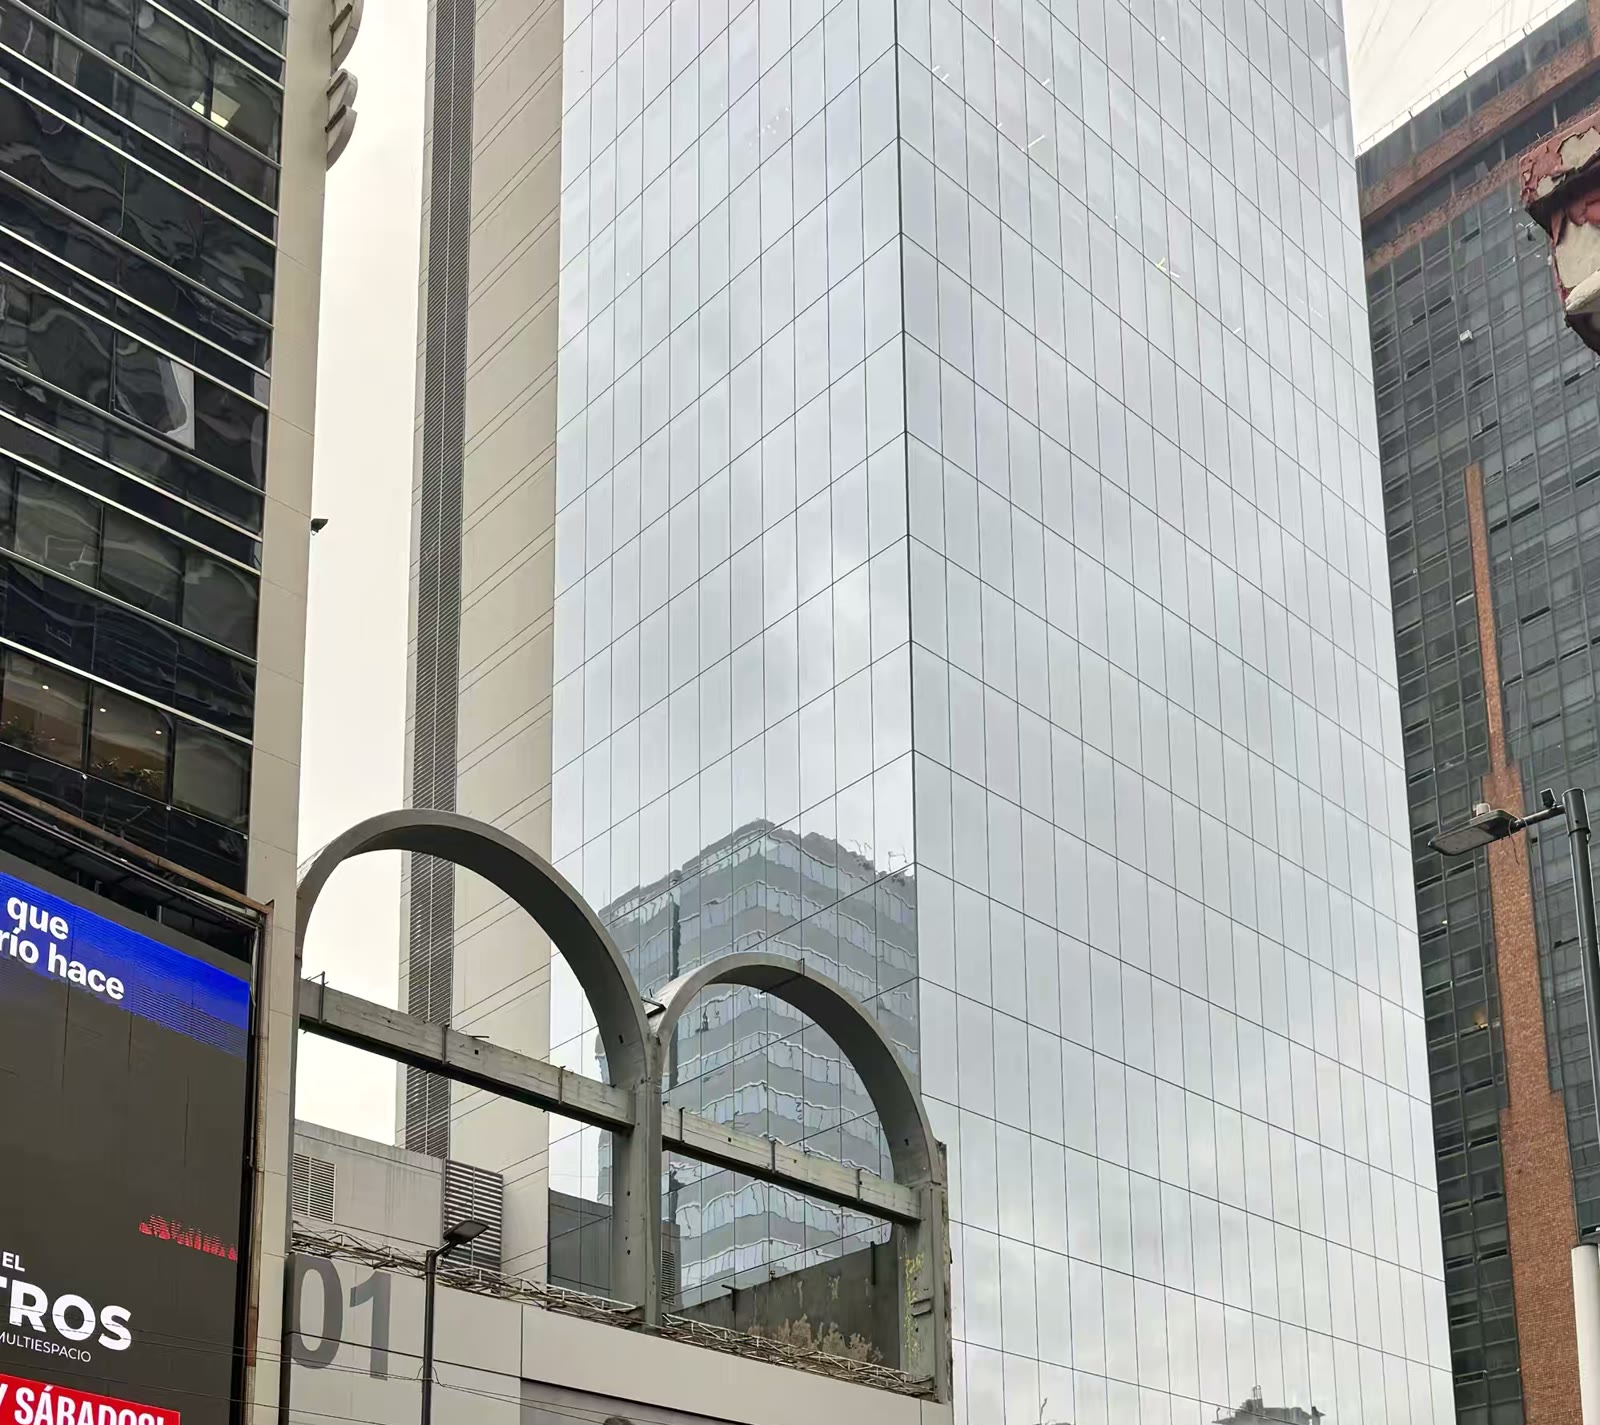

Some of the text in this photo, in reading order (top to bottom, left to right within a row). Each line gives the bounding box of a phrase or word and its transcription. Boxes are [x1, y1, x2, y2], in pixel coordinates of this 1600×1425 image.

[7, 896, 69, 940] que
[47, 942, 125, 1000] hace
[2, 1251, 25, 1272] EL
[0, 1276, 133, 1351] ROS
[287, 1253, 391, 1381] 01
